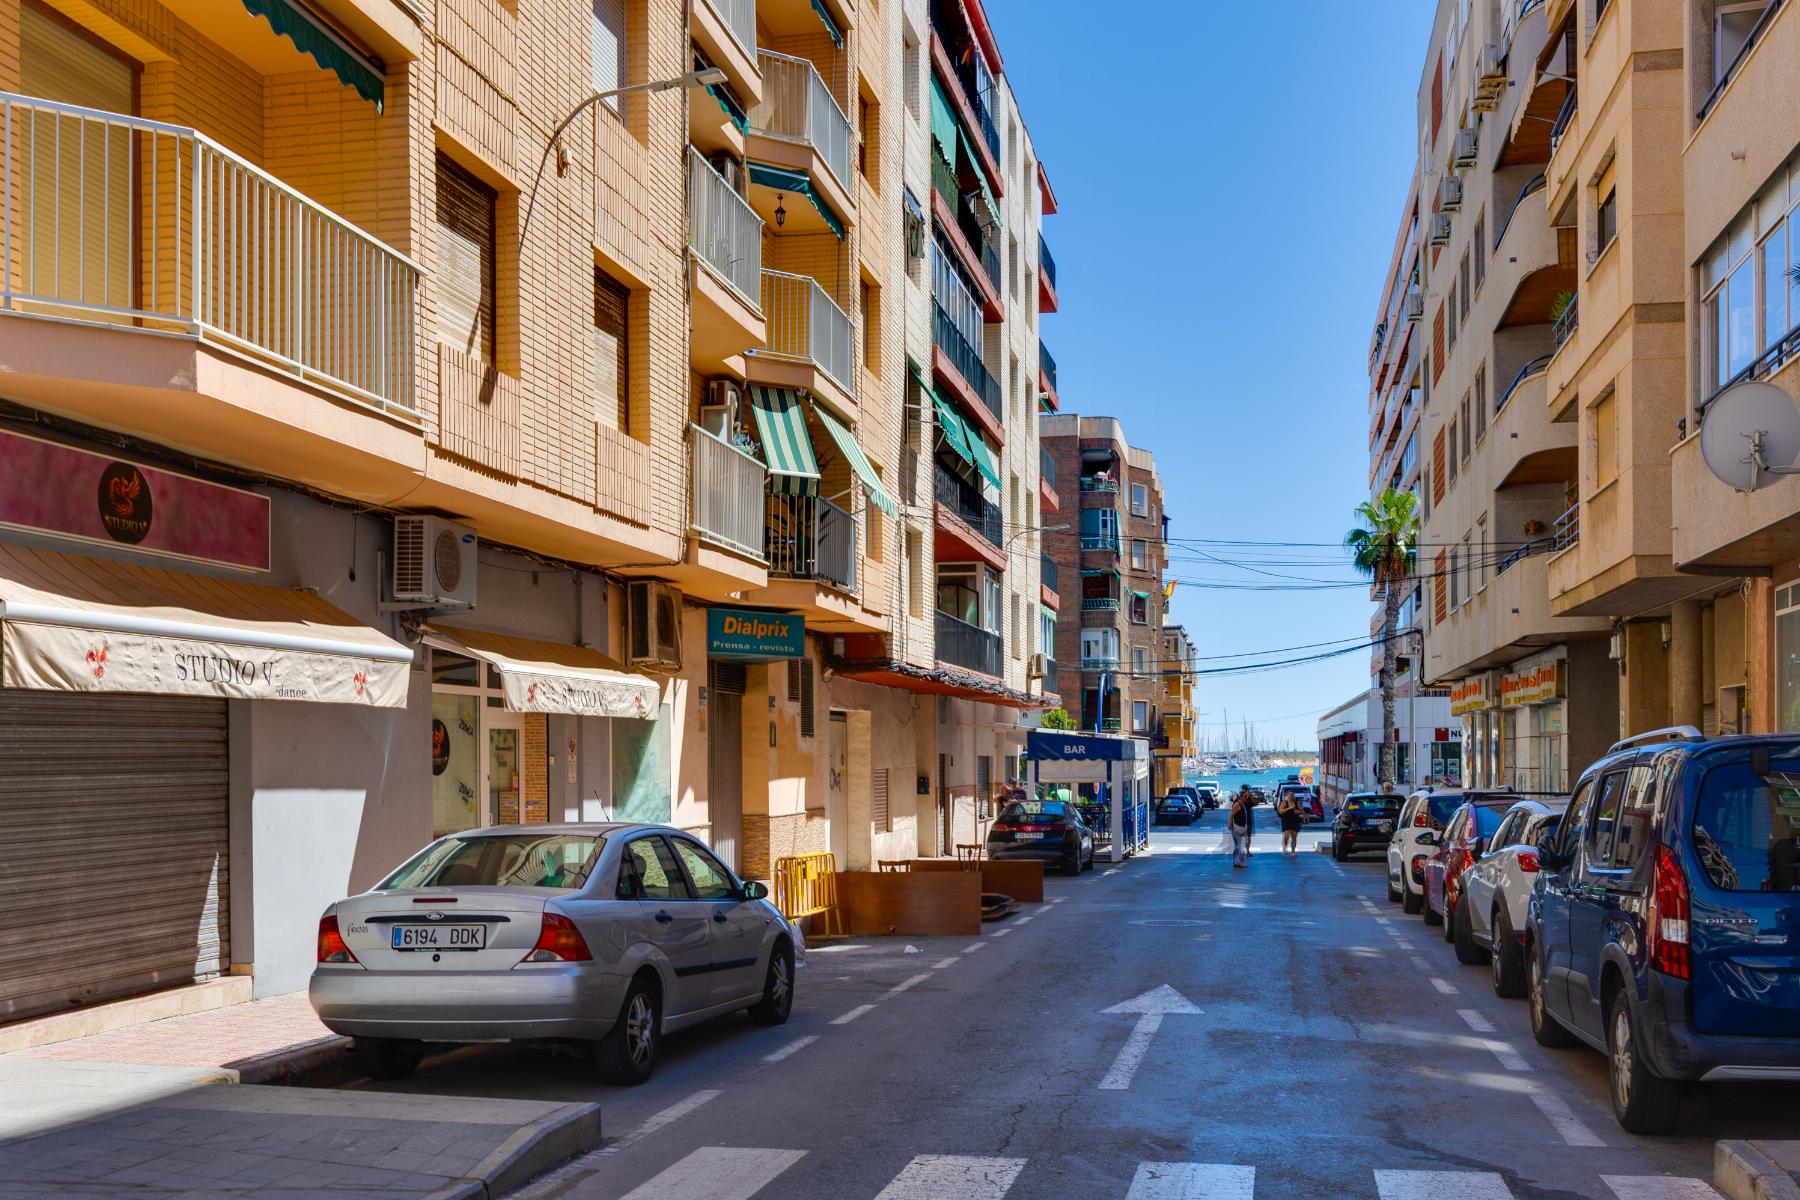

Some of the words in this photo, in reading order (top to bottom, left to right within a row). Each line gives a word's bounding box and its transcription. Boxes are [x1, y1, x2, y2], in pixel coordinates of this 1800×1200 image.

[723, 615, 789, 640] Dialprix
[713, 640, 750, 650] Prensa
[760, 644, 795, 652] revista
[174, 653, 256, 685] STUDIO
[262, 661, 274, 686] V
[278, 685, 307, 698] dance
[1064, 745, 1086, 755] BAR
[403, 928, 438, 945] 6194
[450, 928, 480, 945] DDK
